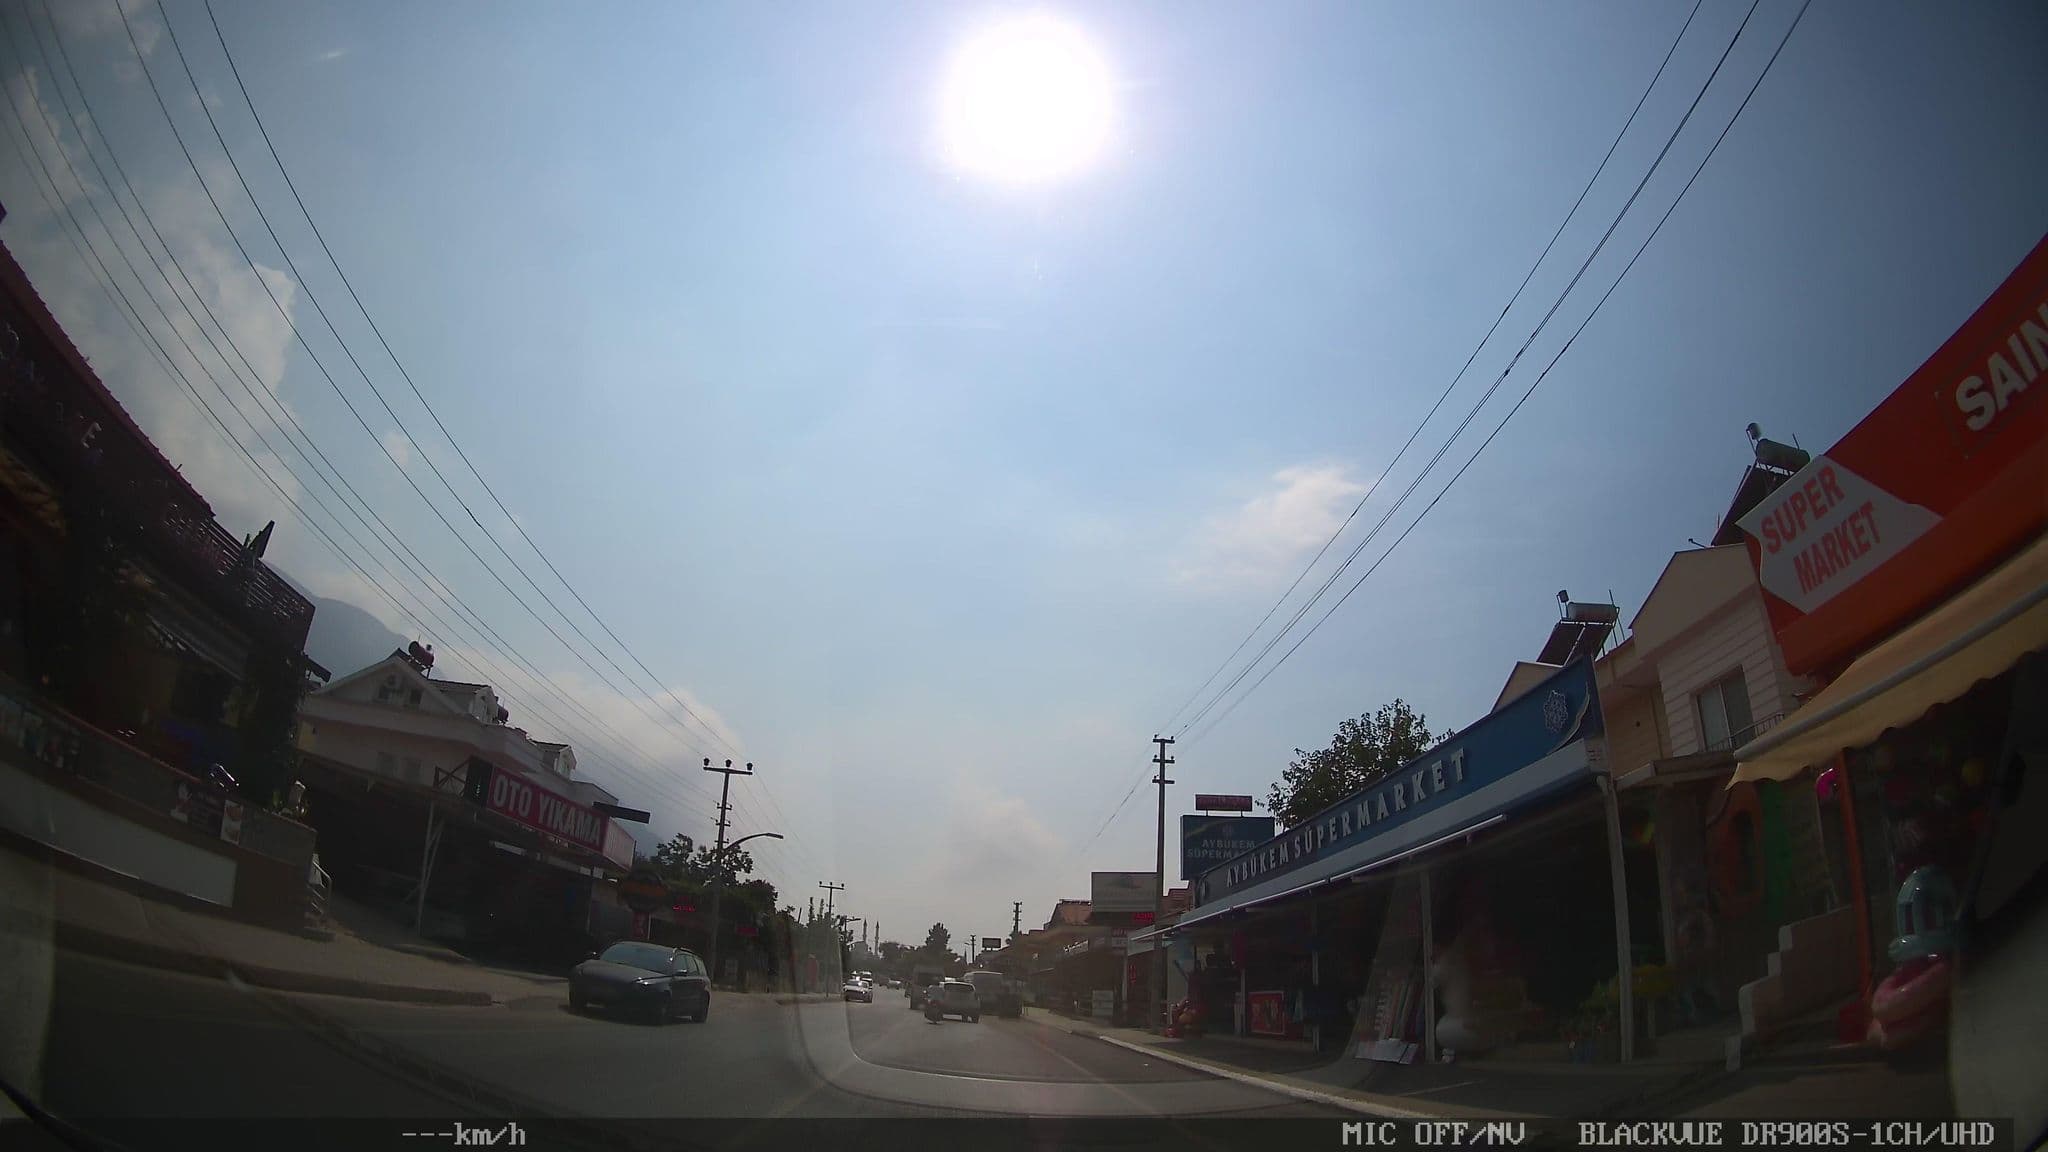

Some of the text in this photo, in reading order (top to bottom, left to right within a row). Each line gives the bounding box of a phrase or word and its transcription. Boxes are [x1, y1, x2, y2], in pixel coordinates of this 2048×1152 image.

[1760, 466, 1845, 555] SUPER
[1793, 501, 1881, 596] MARKET
[493, 775, 602, 848] OTO YIKAMA
